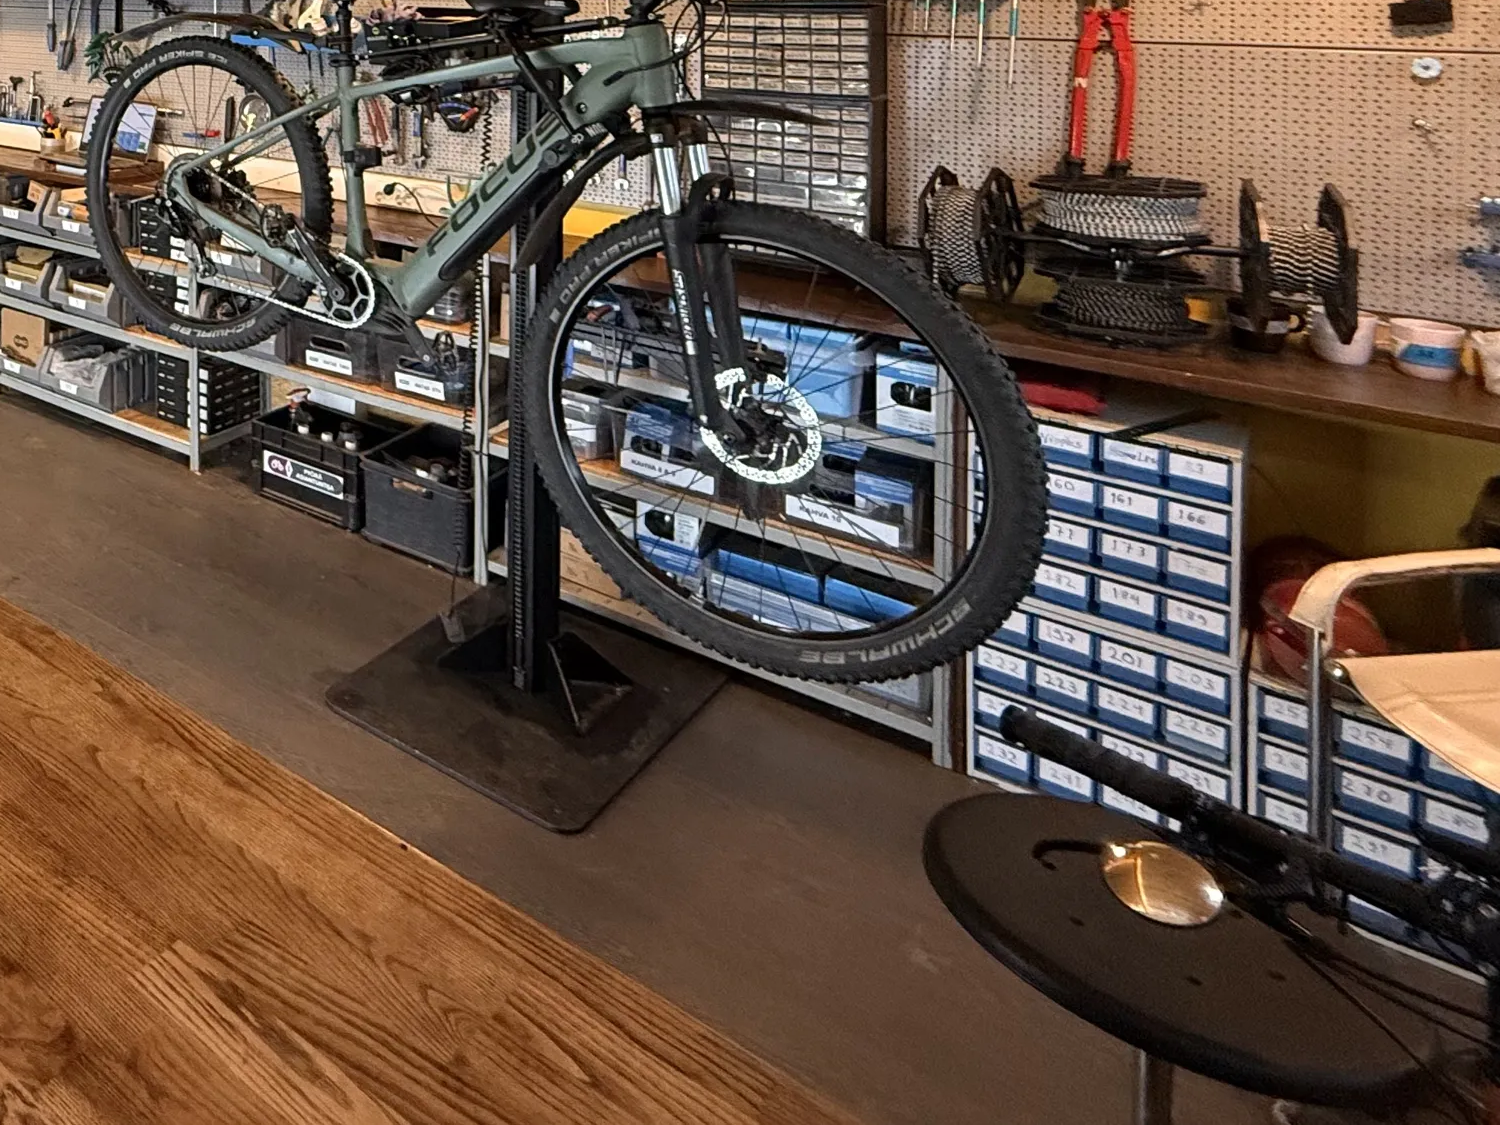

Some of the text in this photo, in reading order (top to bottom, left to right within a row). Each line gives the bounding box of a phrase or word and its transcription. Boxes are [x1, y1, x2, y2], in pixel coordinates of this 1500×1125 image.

[427, 111, 562, 257] FOCUS
[168, 317, 257, 339] SCHWALBE
[798, 597, 973, 665] SCHWALBE
[1108, 644, 1143, 668] 201
[1043, 672, 1077, 695] 223
